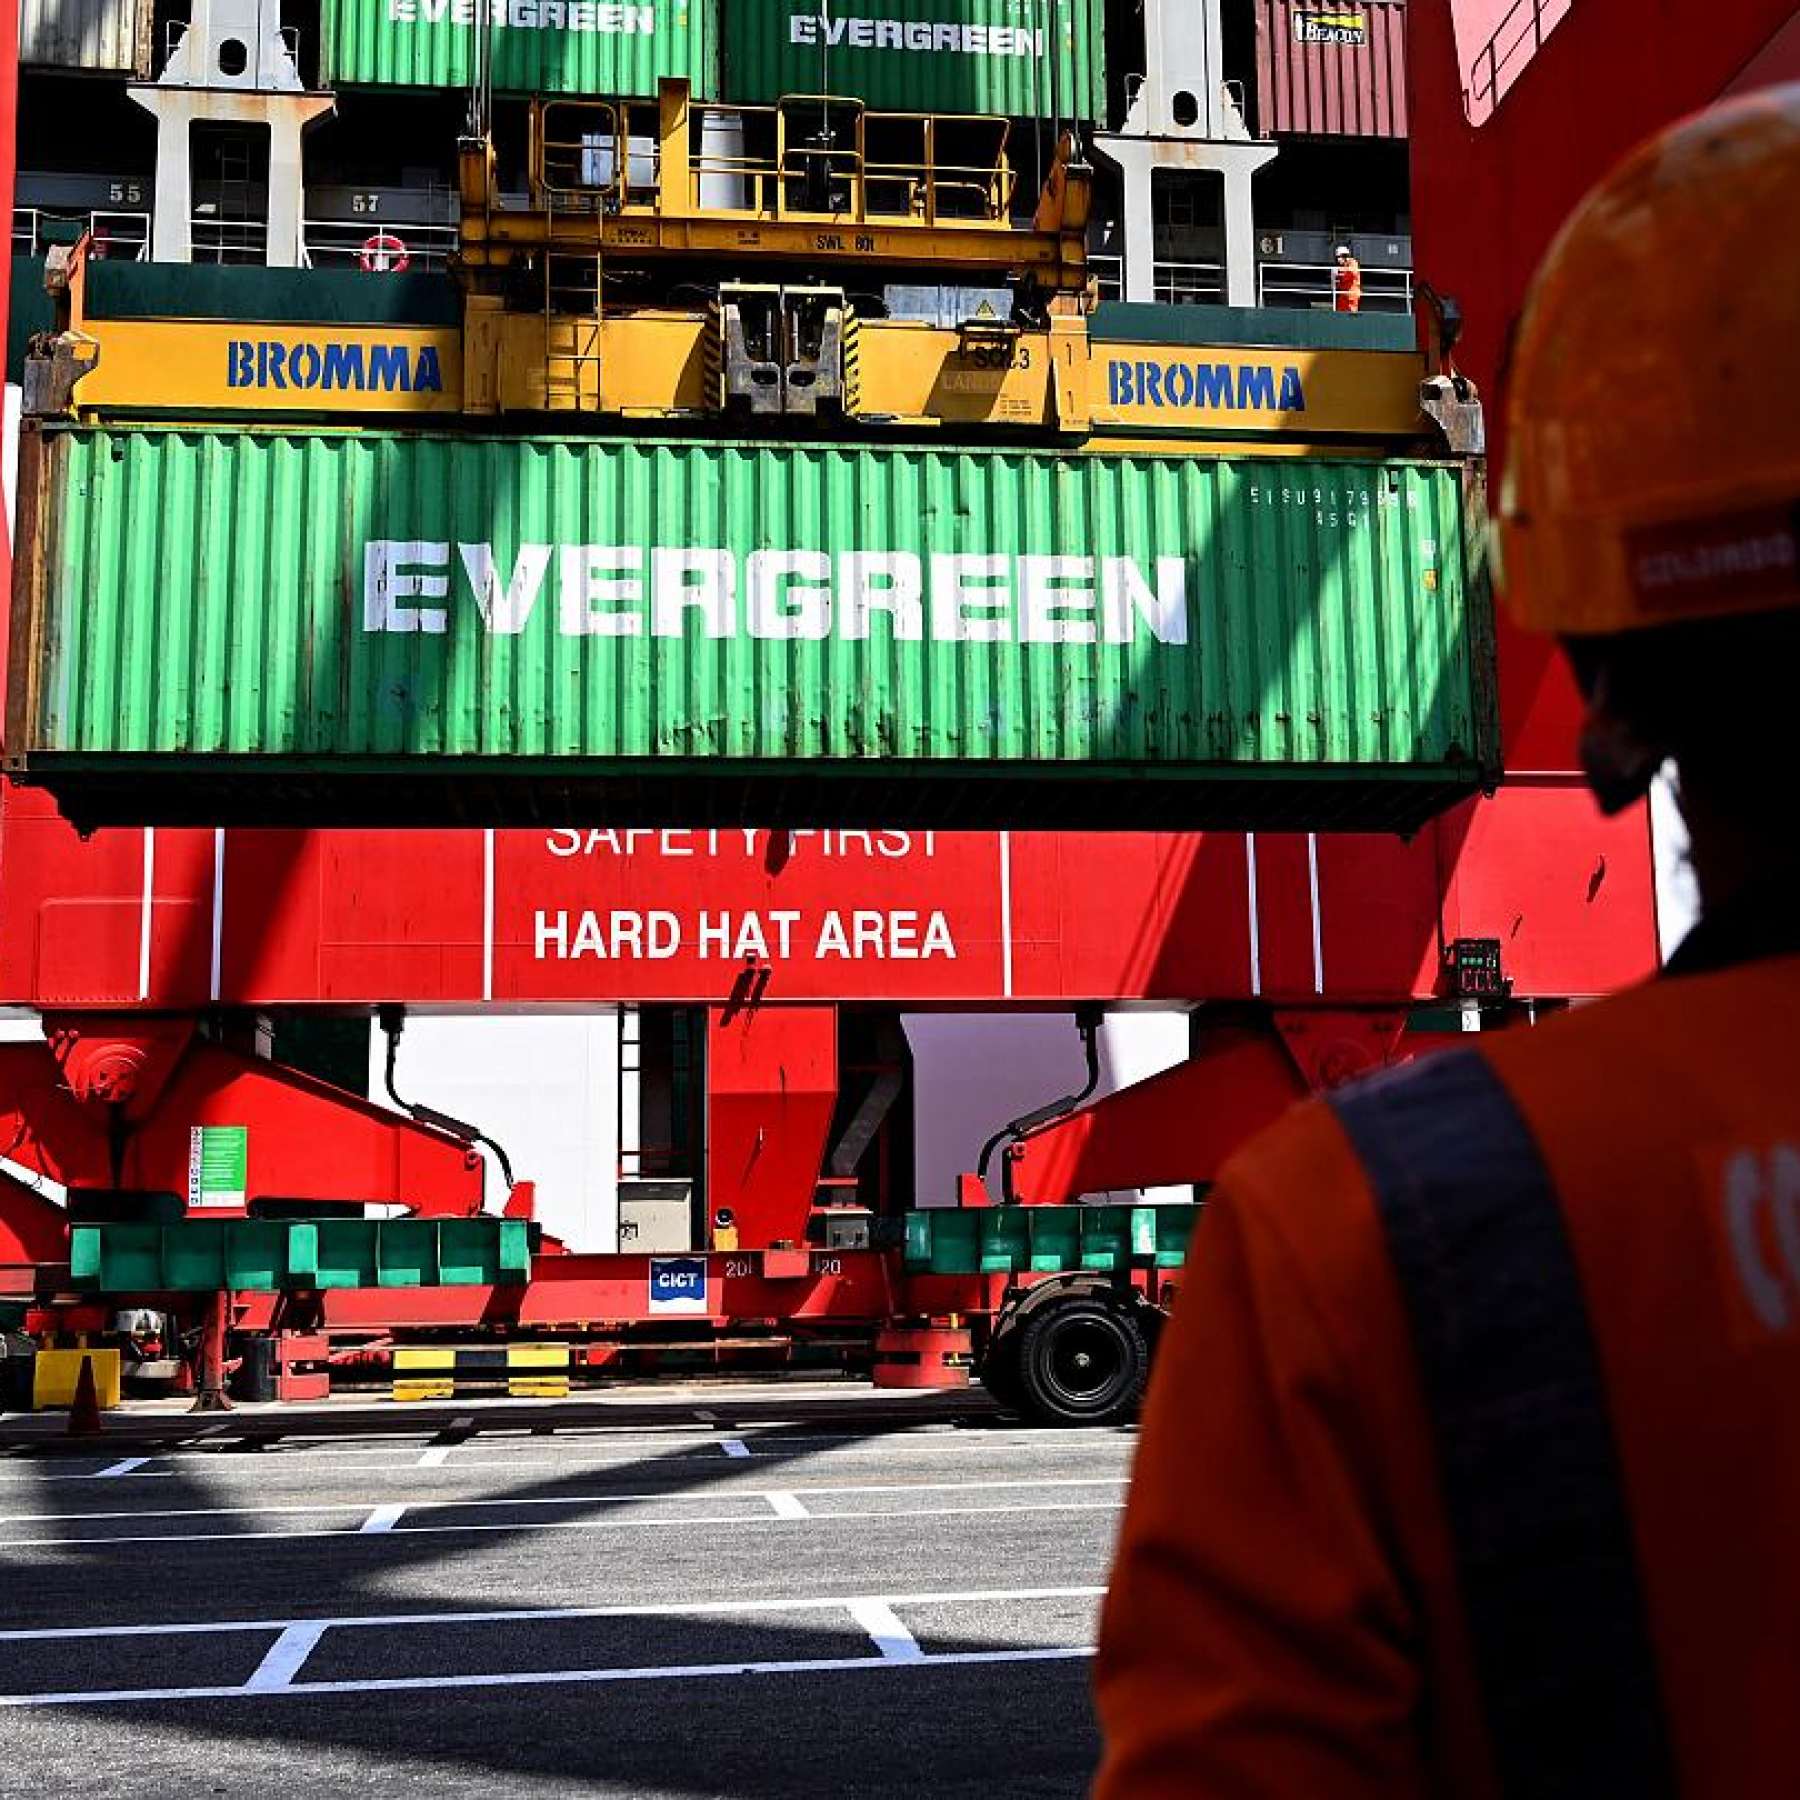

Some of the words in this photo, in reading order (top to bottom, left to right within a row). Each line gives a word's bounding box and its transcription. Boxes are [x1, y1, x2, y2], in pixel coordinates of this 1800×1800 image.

[388, 0, 654, 34] EVERGREEN
[790, 15, 1043, 56] EVERGREEN
[110, 184, 141, 202] 55
[353, 195, 379, 212] 57
[816, 234, 845, 249] SWL
[1260, 237, 1283, 254] 61
[228, 341, 443, 392] BROMMA
[1108, 359, 1306, 411] BROMMA
[364, 540, 1188, 645] EVERGREEN
[534, 910, 681, 959] HARD
[700, 910, 801, 959] HAT
[814, 910, 956, 959] AREA
[659, 1272, 698, 1288] CICT
